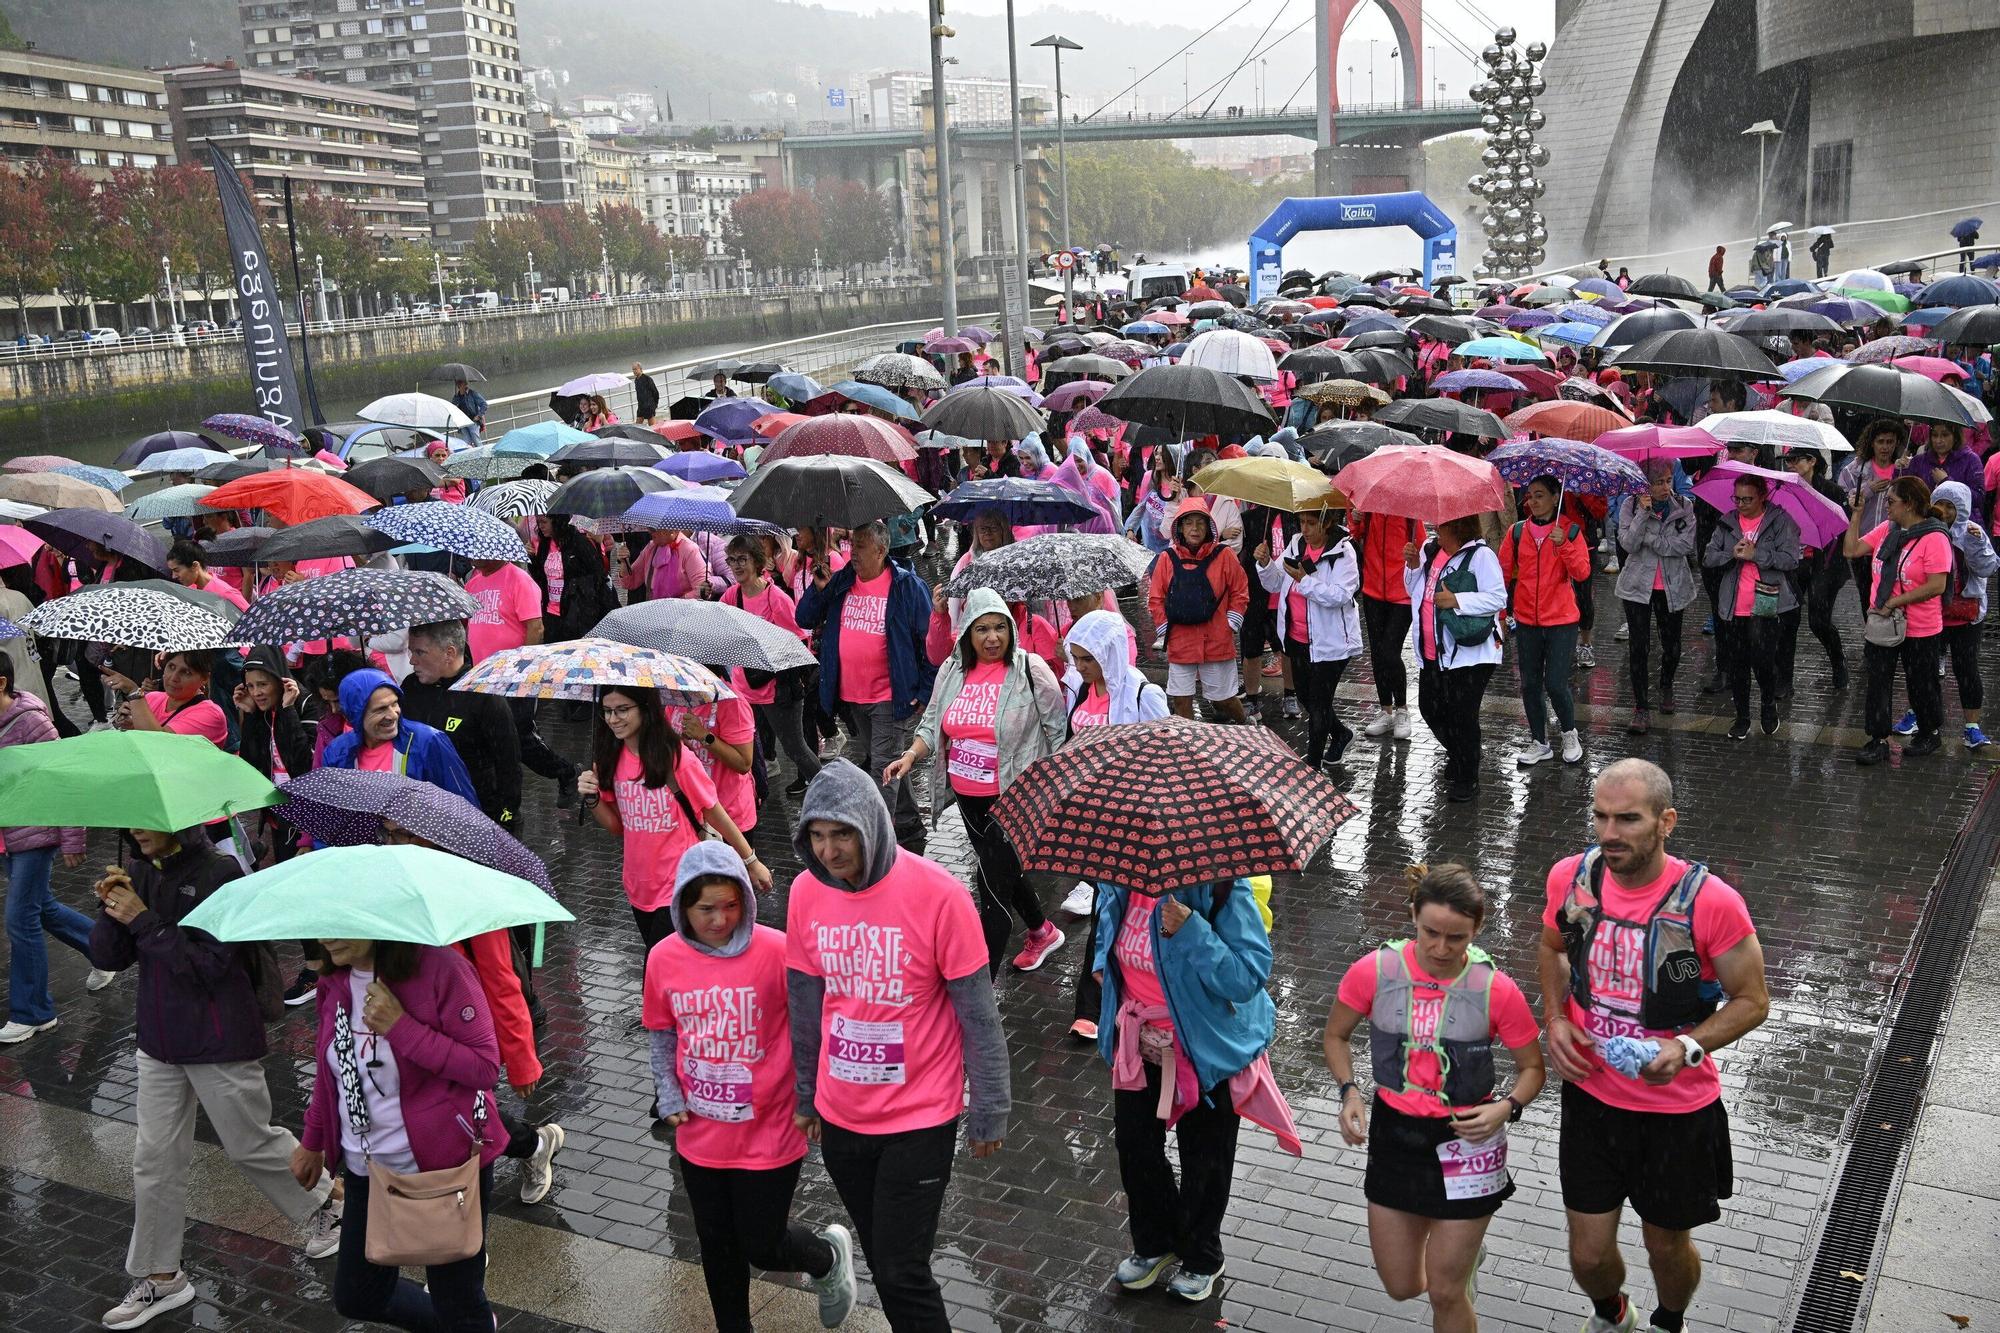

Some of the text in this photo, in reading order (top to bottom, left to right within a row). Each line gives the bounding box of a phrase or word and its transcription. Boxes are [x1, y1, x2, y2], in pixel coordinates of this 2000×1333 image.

[1344, 207, 1373, 220] Kaiku
[946, 711, 996, 728] AVANZ
[957, 751, 986, 768] 2025
[825, 975, 912, 1007] AVANZA
[1592, 1017, 1645, 1040] 2025
[838, 1040, 886, 1062] 2025
[693, 1080, 736, 1101] 2025
[1459, 1148, 1503, 1173] 2025
